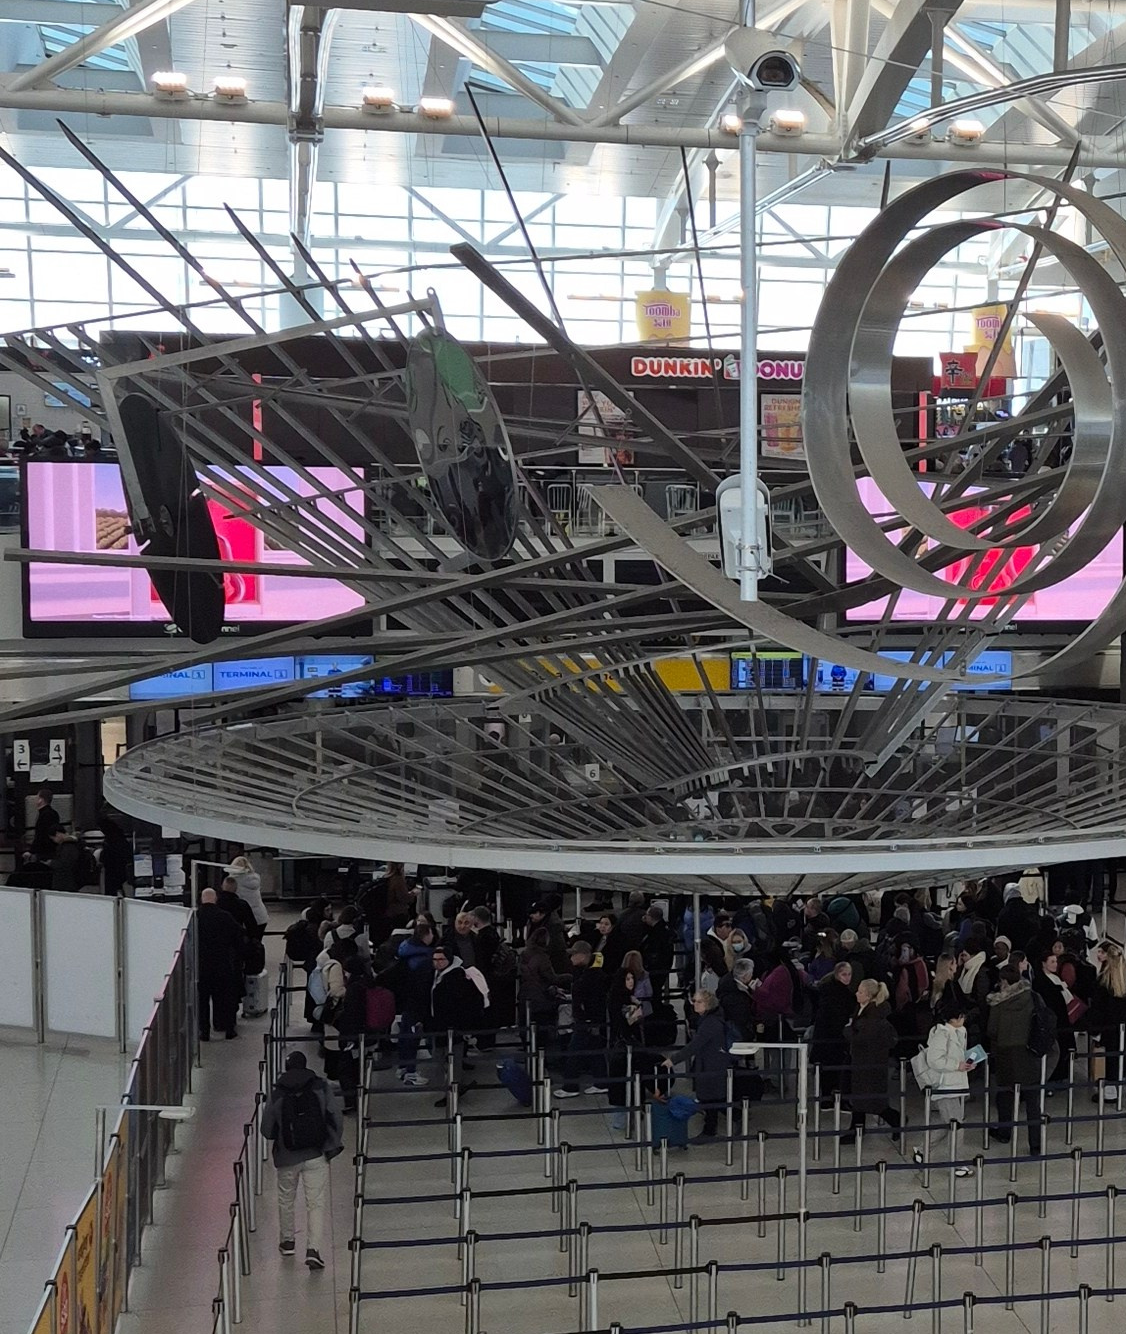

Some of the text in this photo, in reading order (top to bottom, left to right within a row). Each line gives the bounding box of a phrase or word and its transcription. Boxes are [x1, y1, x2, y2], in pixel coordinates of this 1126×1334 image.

[219, 671, 272, 679] TERMINAL
[18, 744, 25, 754] 3
[53, 744, 60, 754] 4
